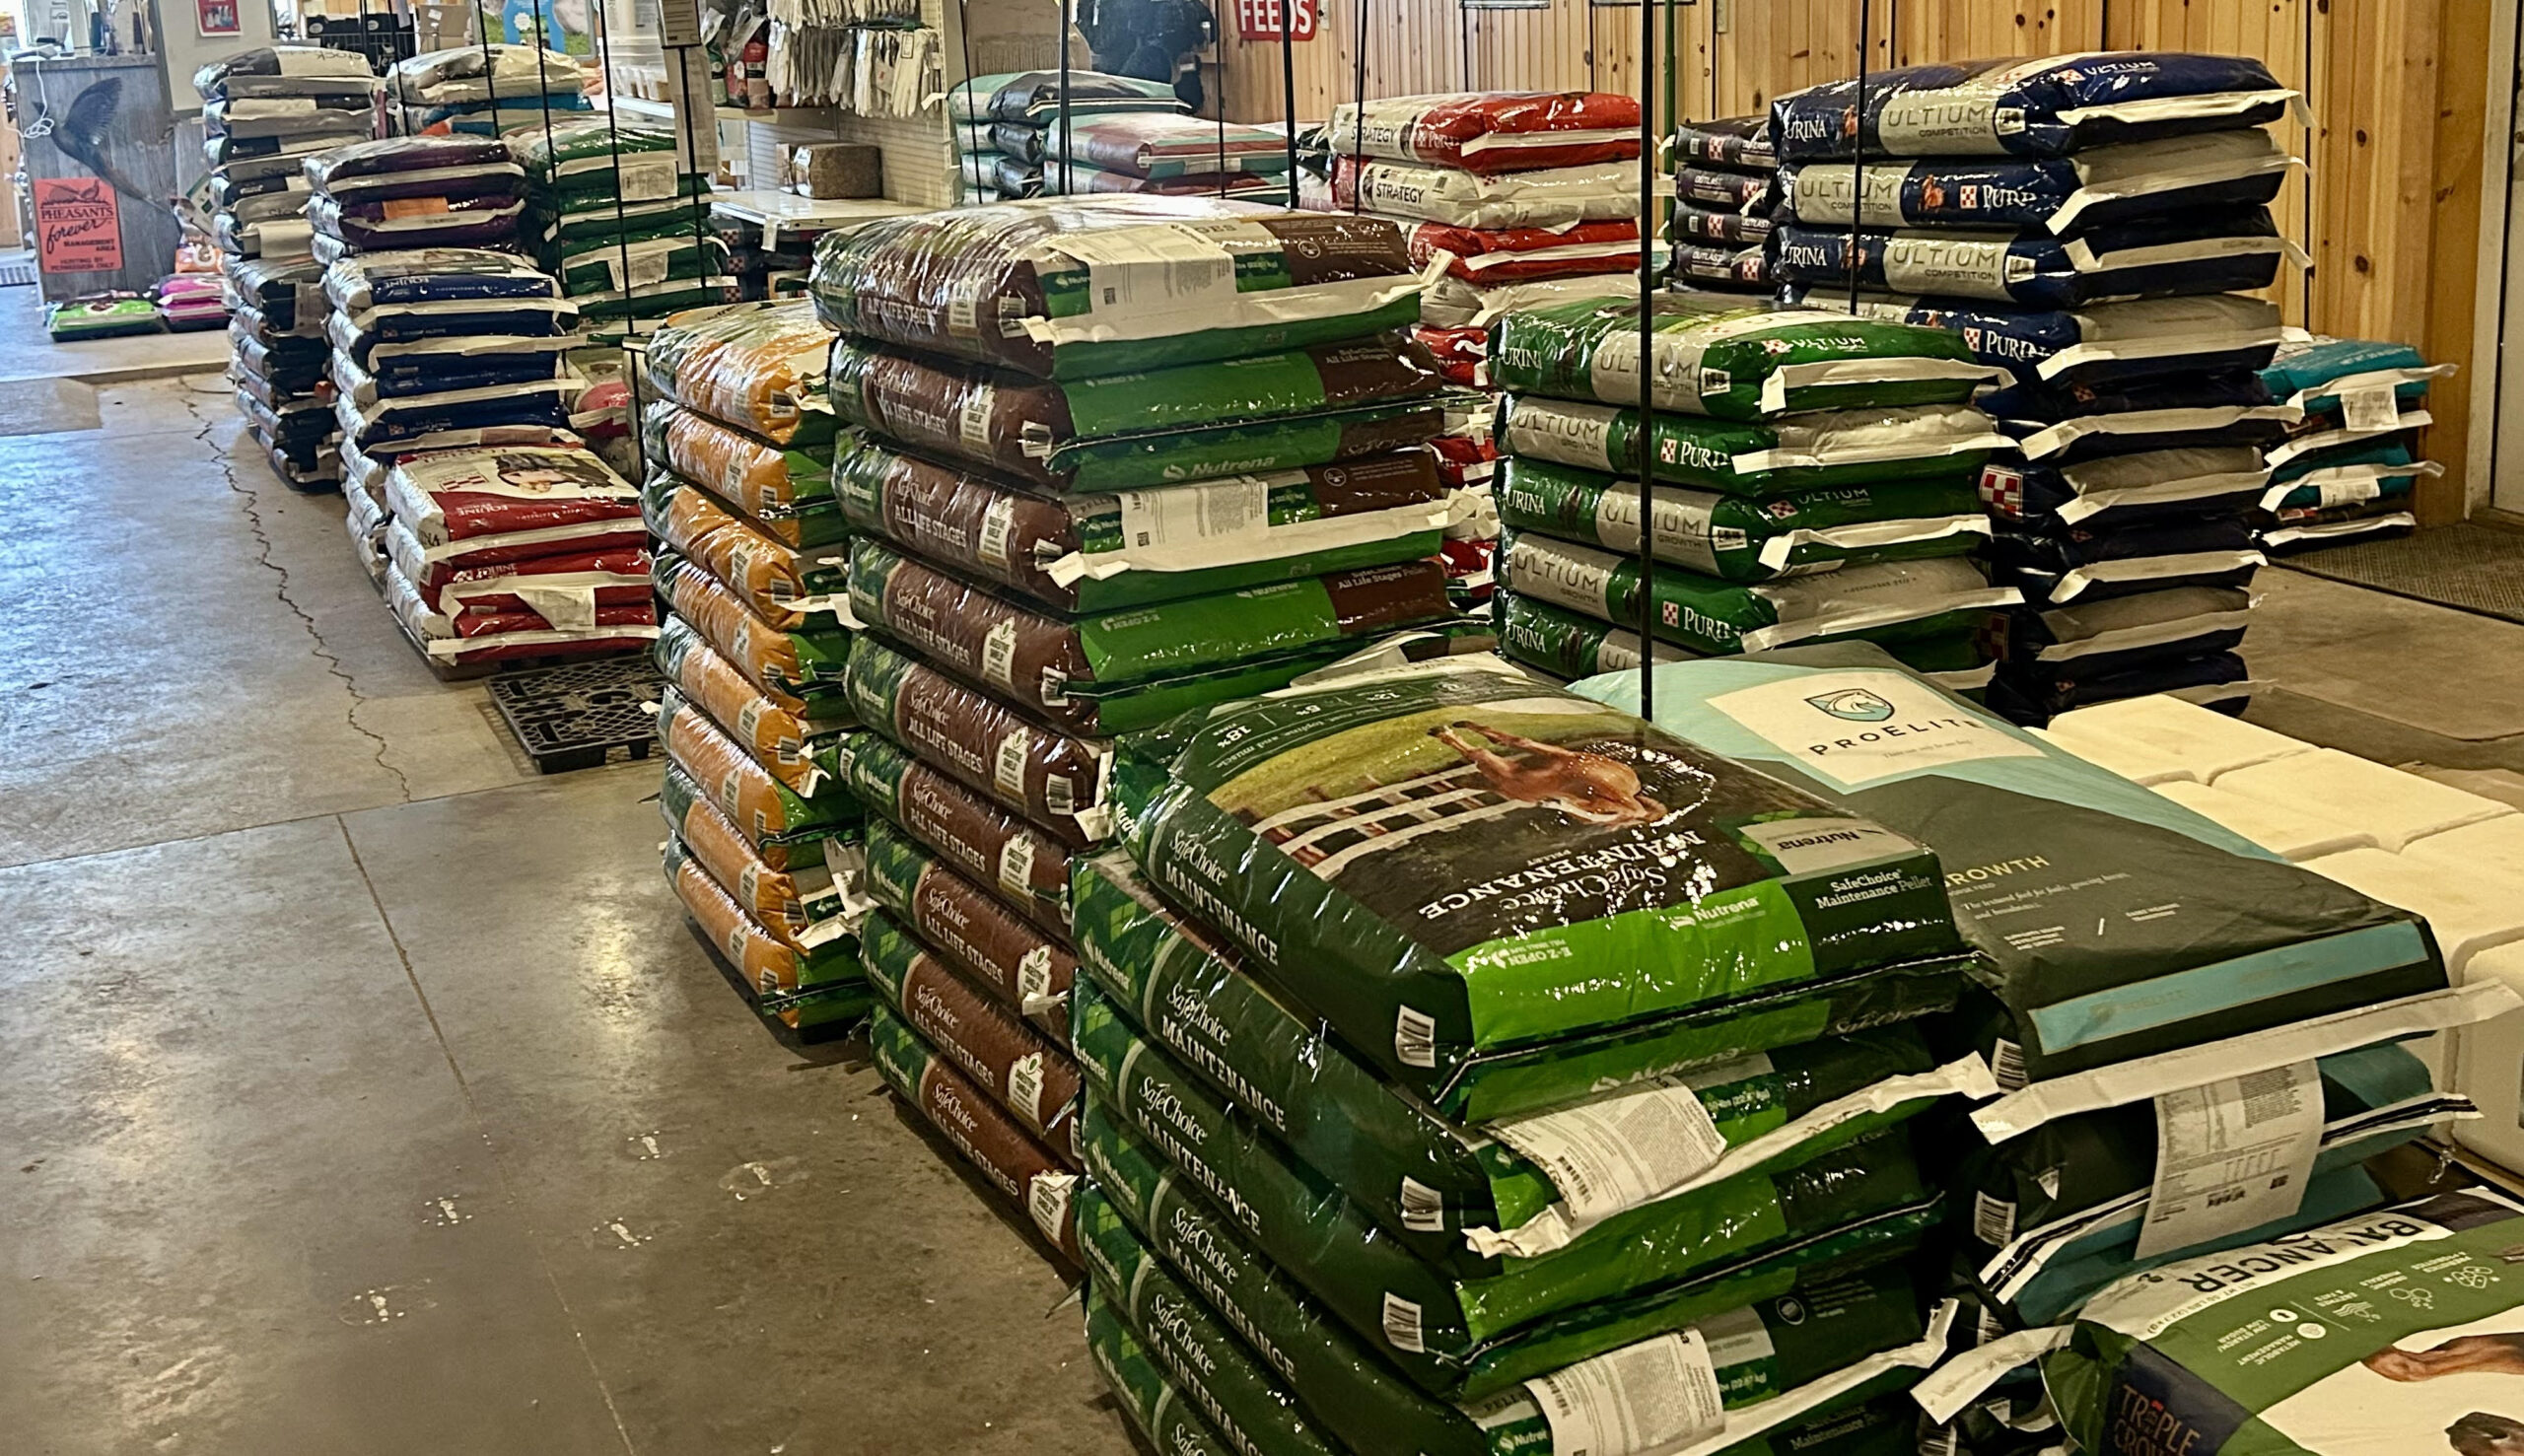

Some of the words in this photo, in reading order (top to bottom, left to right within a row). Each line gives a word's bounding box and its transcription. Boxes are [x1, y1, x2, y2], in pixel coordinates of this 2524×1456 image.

[2084, 61, 2156, 76] ULTIUM
[1785, 119, 1828, 142] URINA
[1887, 105, 1987, 127] ULTIUM
[1351, 126, 1398, 143] SRATEGY
[1919, 127, 1987, 138] COMPETITION
[1376, 182, 1426, 204] STRATEGY
[1801, 180, 1893, 200] ULTIUM
[41, 207, 113, 219] PHEASANTS
[1831, 201, 1892, 211] COMPTITION
[46, 219, 107, 254] forever
[1785, 244, 1828, 268] URINA
[1893, 246, 1997, 268] ULTIUM
[1925, 269, 1996, 281] COMPETITION
[1792, 337, 1866, 352] ULTIUM
[1501, 347, 1542, 371] URINA
[1600, 353, 1693, 380] ULTUM
[1516, 411, 1601, 441] ULTIUM
[1191, 454, 1277, 477] Nutrena
[1798, 488, 1869, 504] ULTIUM
[1502, 490, 1546, 515] URINA
[1605, 502, 1706, 537] ULIUM
[931, 519, 966, 548] STAGES
[1657, 533, 1703, 548] GROWTH
[1338, 577, 1352, 589] All
[1354, 575, 1371, 587] Life
[1373, 571, 1402, 584] Stages
[1514, 552, 1598, 593] ULTIUM
[895, 613, 913, 637] ALL
[914, 623, 935, 649] LIFE
[936, 633, 972, 667] STAGES
[1505, 622, 1547, 654] URINA
[909, 691, 951, 728] SafeChoice
[1295, 704, 1322, 718] 5%
[908, 717, 927, 740] ALL
[927, 727, 947, 753] LIFE
[947, 738, 985, 775] STAGES
[1217, 726, 1253, 749] 18%
[912, 782, 953, 820] SafeChoice
[910, 807, 929, 831] ALL
[929, 819, 949, 847] LIFE
[949, 832, 986, 873] STAGES
[1778, 830, 1861, 853] Nutrena
[1169, 829, 1229, 887] SafeChoice
[1528, 848, 1573, 867] PELLET
[1946, 855, 2051, 887] ROWTH
[1419, 830, 1707, 921] MAINTENANCE
[1499, 864, 1668, 911] SafeChoice
[1831, 868, 1903, 894] SafeChoice
[1815, 883, 1899, 910] Maintenance
[1899, 874, 1933, 893] Pellet
[926, 886, 970, 932] SafeChoice
[1165, 861, 1279, 967] MAINTENANCE
[1694, 896, 1760, 923] Nutrena
[925, 914, 944, 939] ALL
[944, 925, 966, 957] LIFE
[966, 943, 1005, 987] STAGES
[1507, 950, 1547, 967] OPEN
[1546, 946, 1574, 961] E-Z
[1093, 946, 1132, 992] Nutrena
[914, 983, 959, 1029] SafeChoice
[1165, 980, 1231, 1048] SafeChoice
[914, 1010, 933, 1036] ALL
[935, 1024, 956, 1053] LIFE
[955, 1044, 995, 1088] STAGES
[1161, 1014, 1288, 1133] MAINTENANCE
[933, 1082, 979, 1135] SafeChoice
[1139, 1075, 1209, 1146] SafeChoice
[951, 1125, 973, 1157] LIFE
[973, 1144, 1019, 1199] STAGES
[1137, 1108, 1262, 1236] MAINTENANCE
[1170, 1206, 1239, 1285] SafeChoice
[1167, 1237, 1297, 1382] MAINTENANCE
[1152, 1293, 1218, 1377] SafeChoice
[2216, 1326, 2249, 1346] SUGAR
[2245, 1318, 2267, 1332] LOW
[2254, 1338, 2303, 1366] METABOLIC
[1484, 1391, 1527, 1414] PELLE
[1513, 1428, 1548, 1447] Nutre
